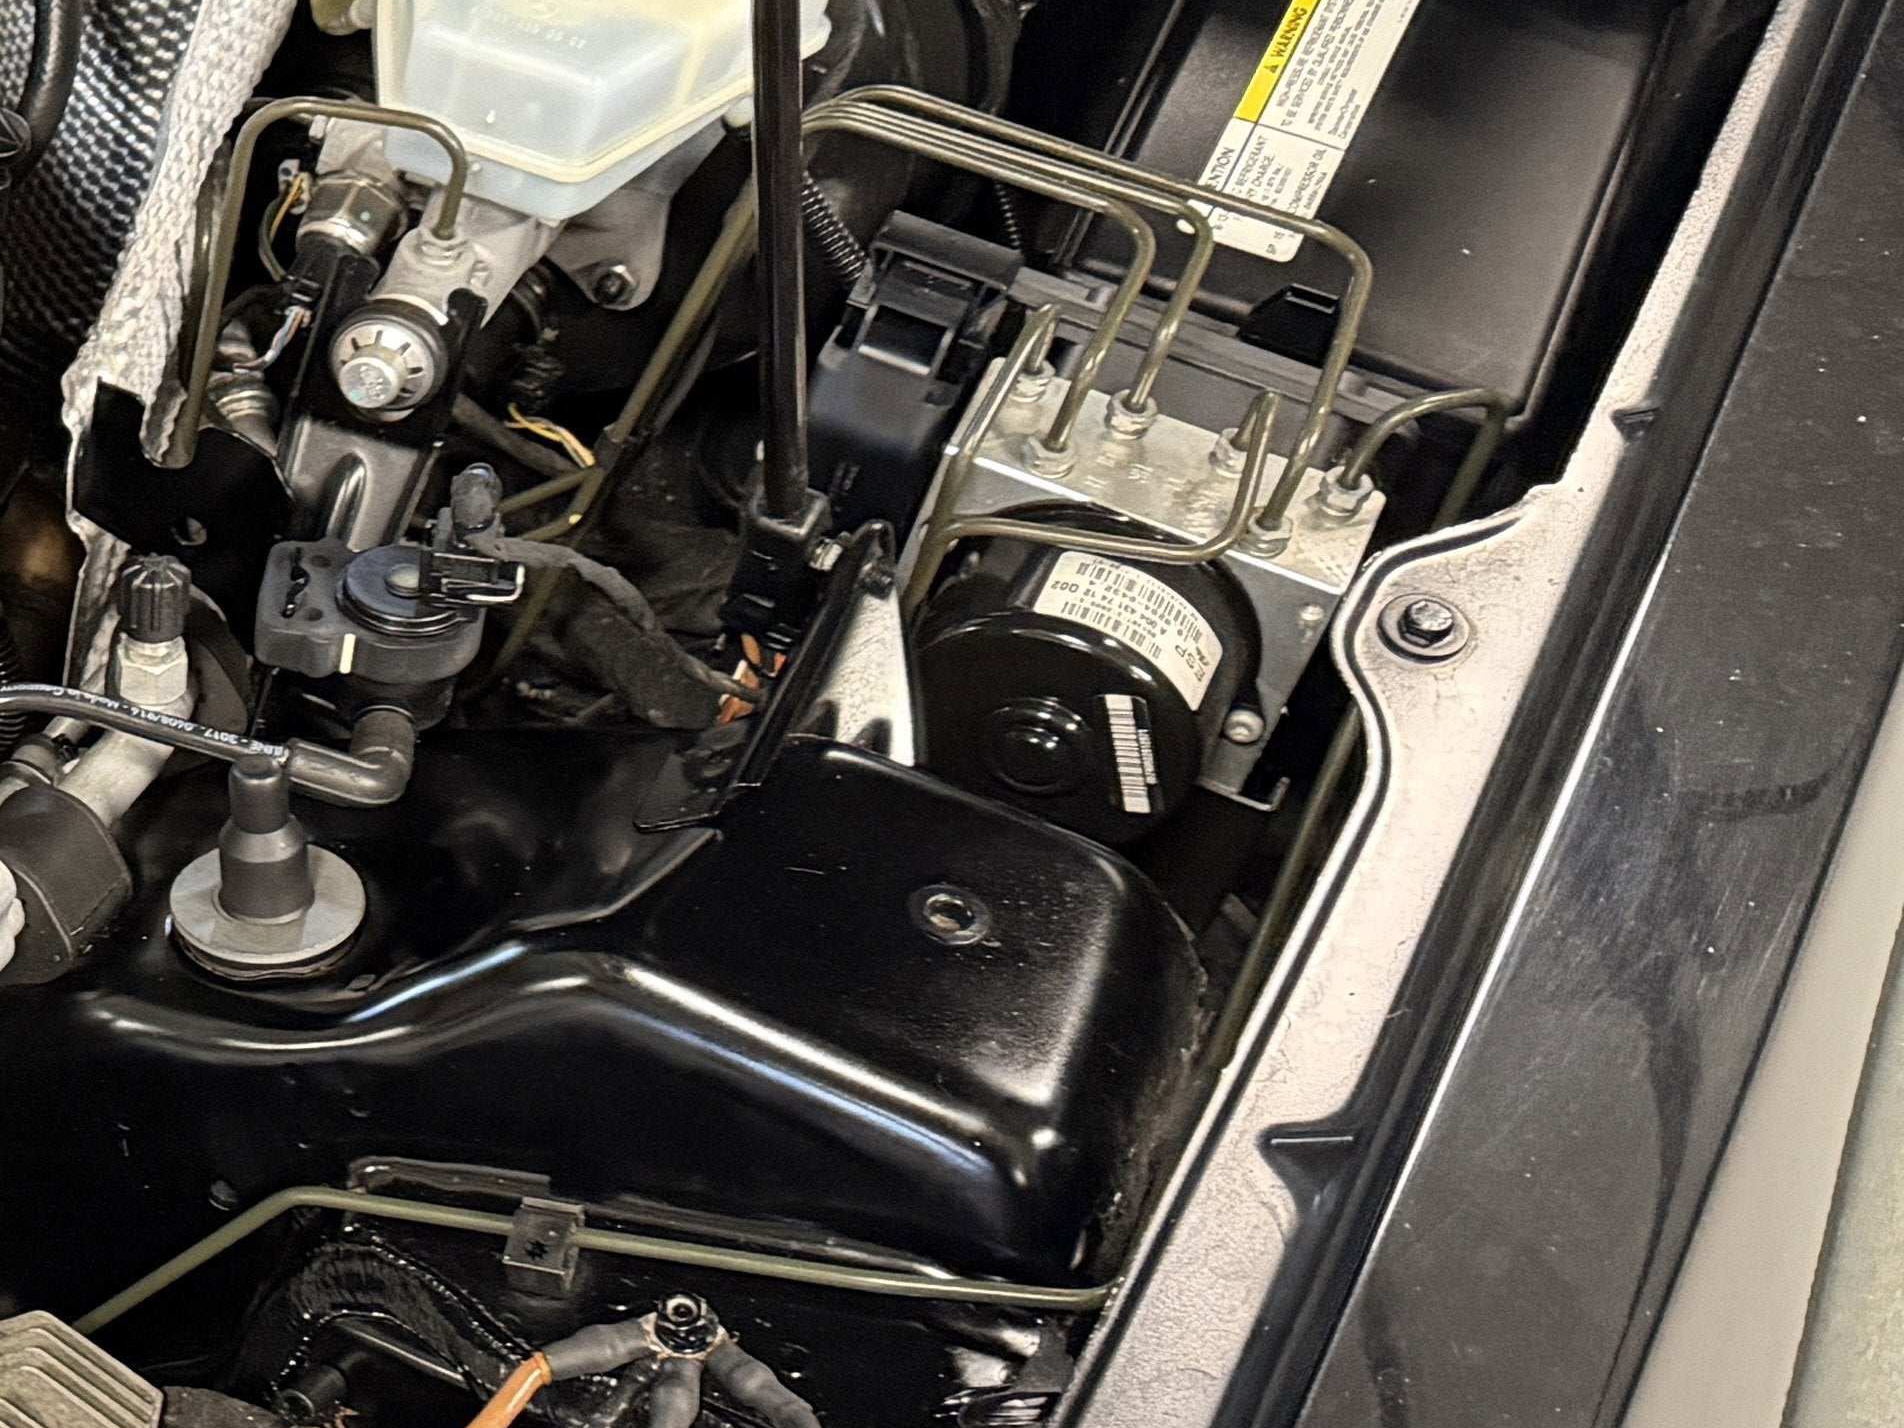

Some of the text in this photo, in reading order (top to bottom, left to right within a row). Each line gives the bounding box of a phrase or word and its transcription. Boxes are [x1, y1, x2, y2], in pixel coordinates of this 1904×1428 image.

[1271, 3, 1308, 59] WARNING
[1311, 145, 1327, 162] OIL
[1049, 571, 1081, 601] Q02
[1082, 585, 1098, 601] 12
[1099, 592, 1115, 608] 74
[1173, 639, 1208, 683] ESP
